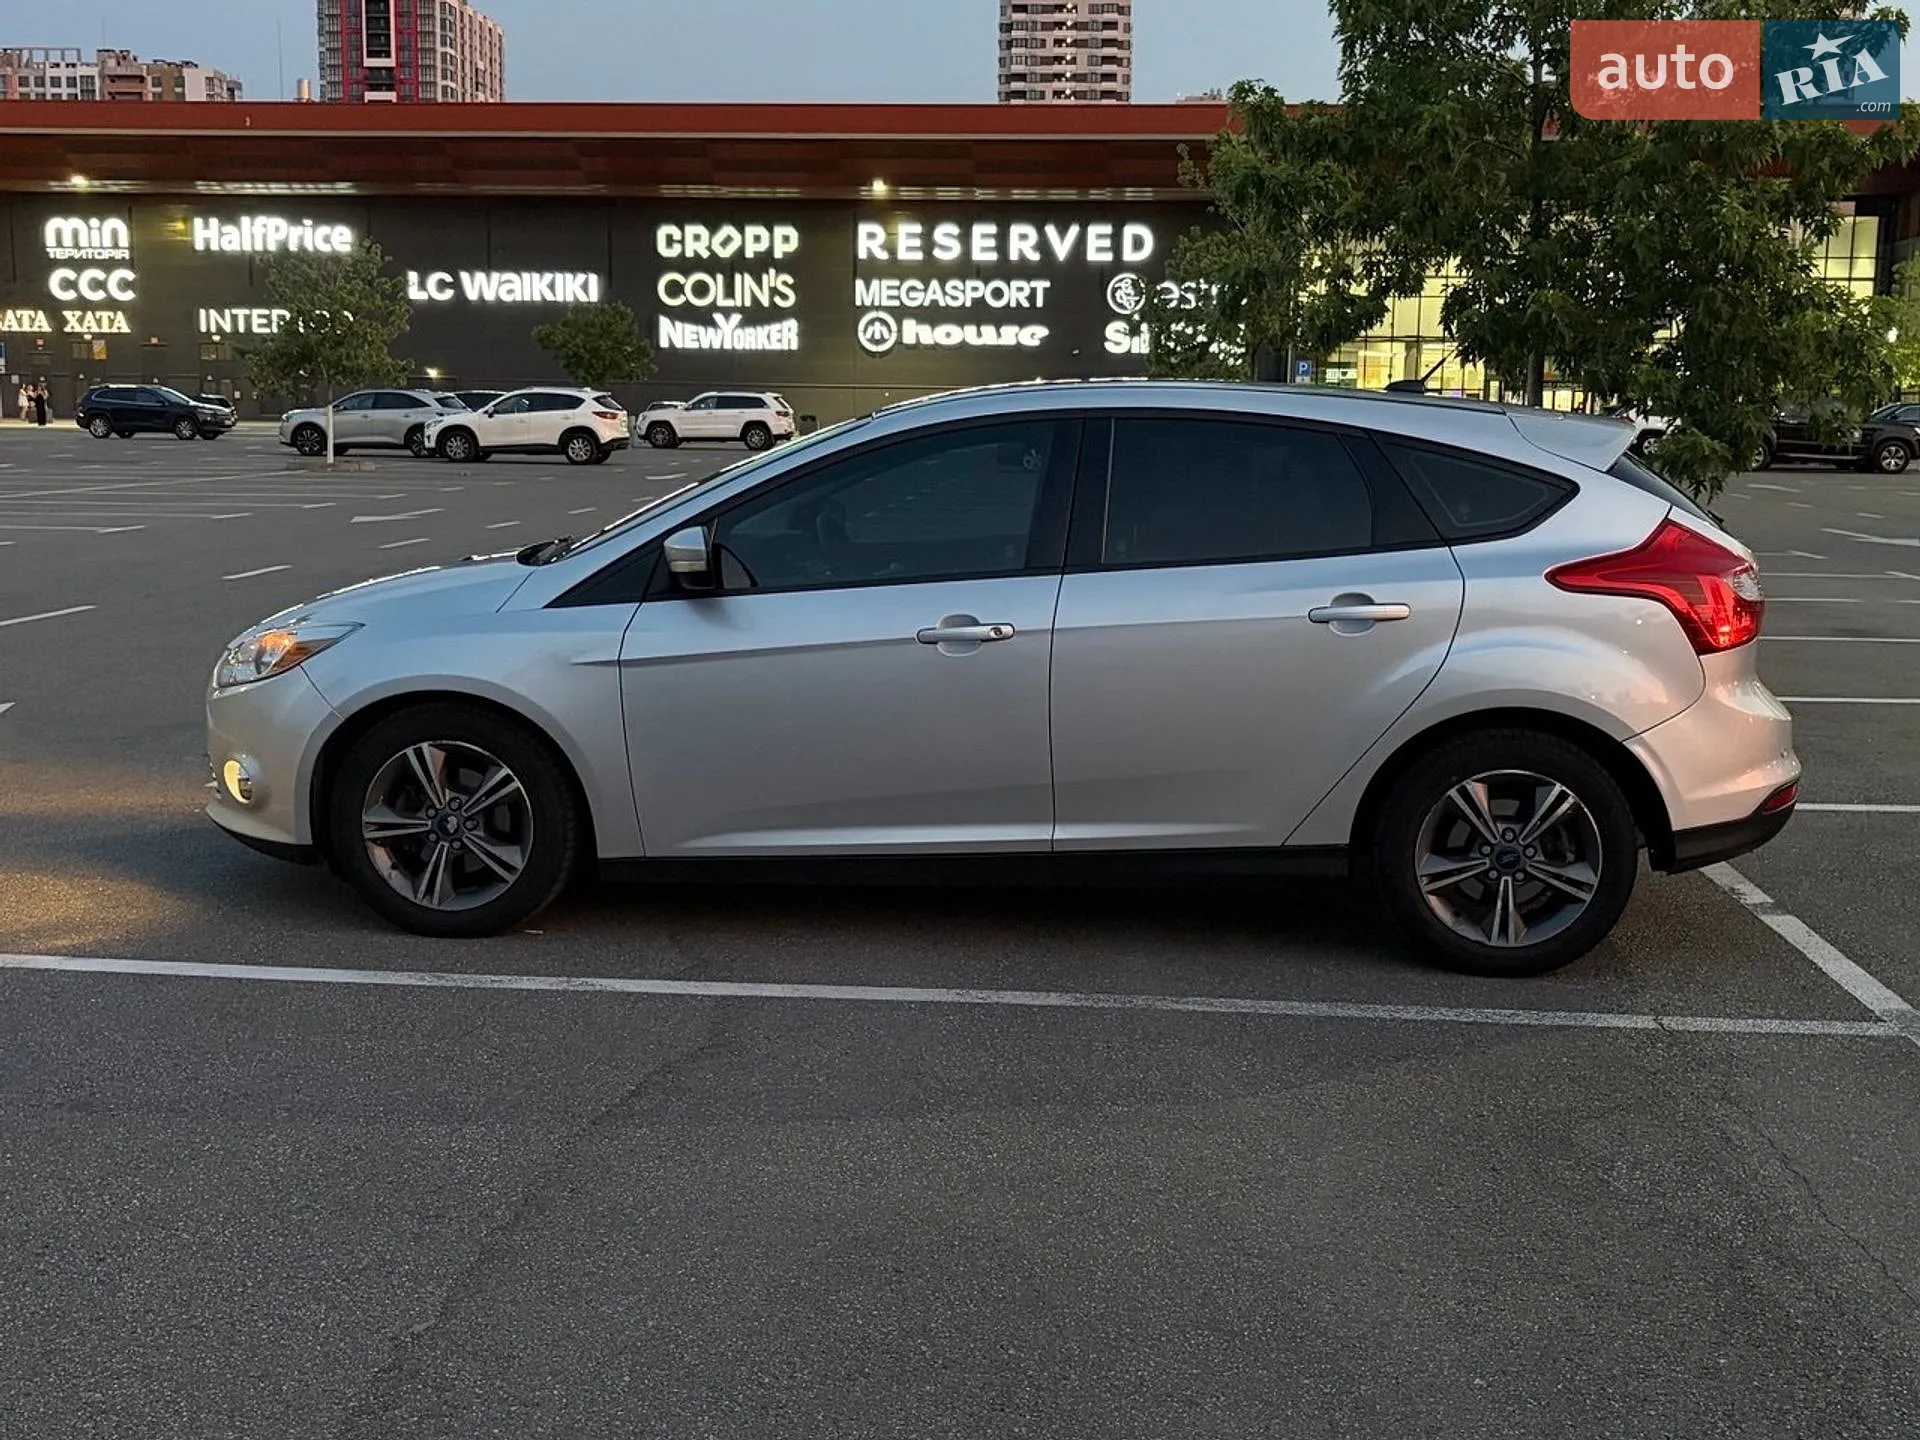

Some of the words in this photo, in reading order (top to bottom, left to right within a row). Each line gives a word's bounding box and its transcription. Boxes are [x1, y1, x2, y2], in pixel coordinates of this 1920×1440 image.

[44, 216, 130, 248] min
[193, 216, 352, 252] HalfPrice
[656, 224, 799, 260] CROPP
[857, 222, 1155, 263] RESERVED
[48, 267, 137, 302] CCC
[407, 270, 455, 301] LC
[657, 267, 797, 308] COLIN'S
[855, 278, 1052, 308] MEGASPORT
[0, 309, 52, 333] АТА
[902, 318, 1050, 347] house
